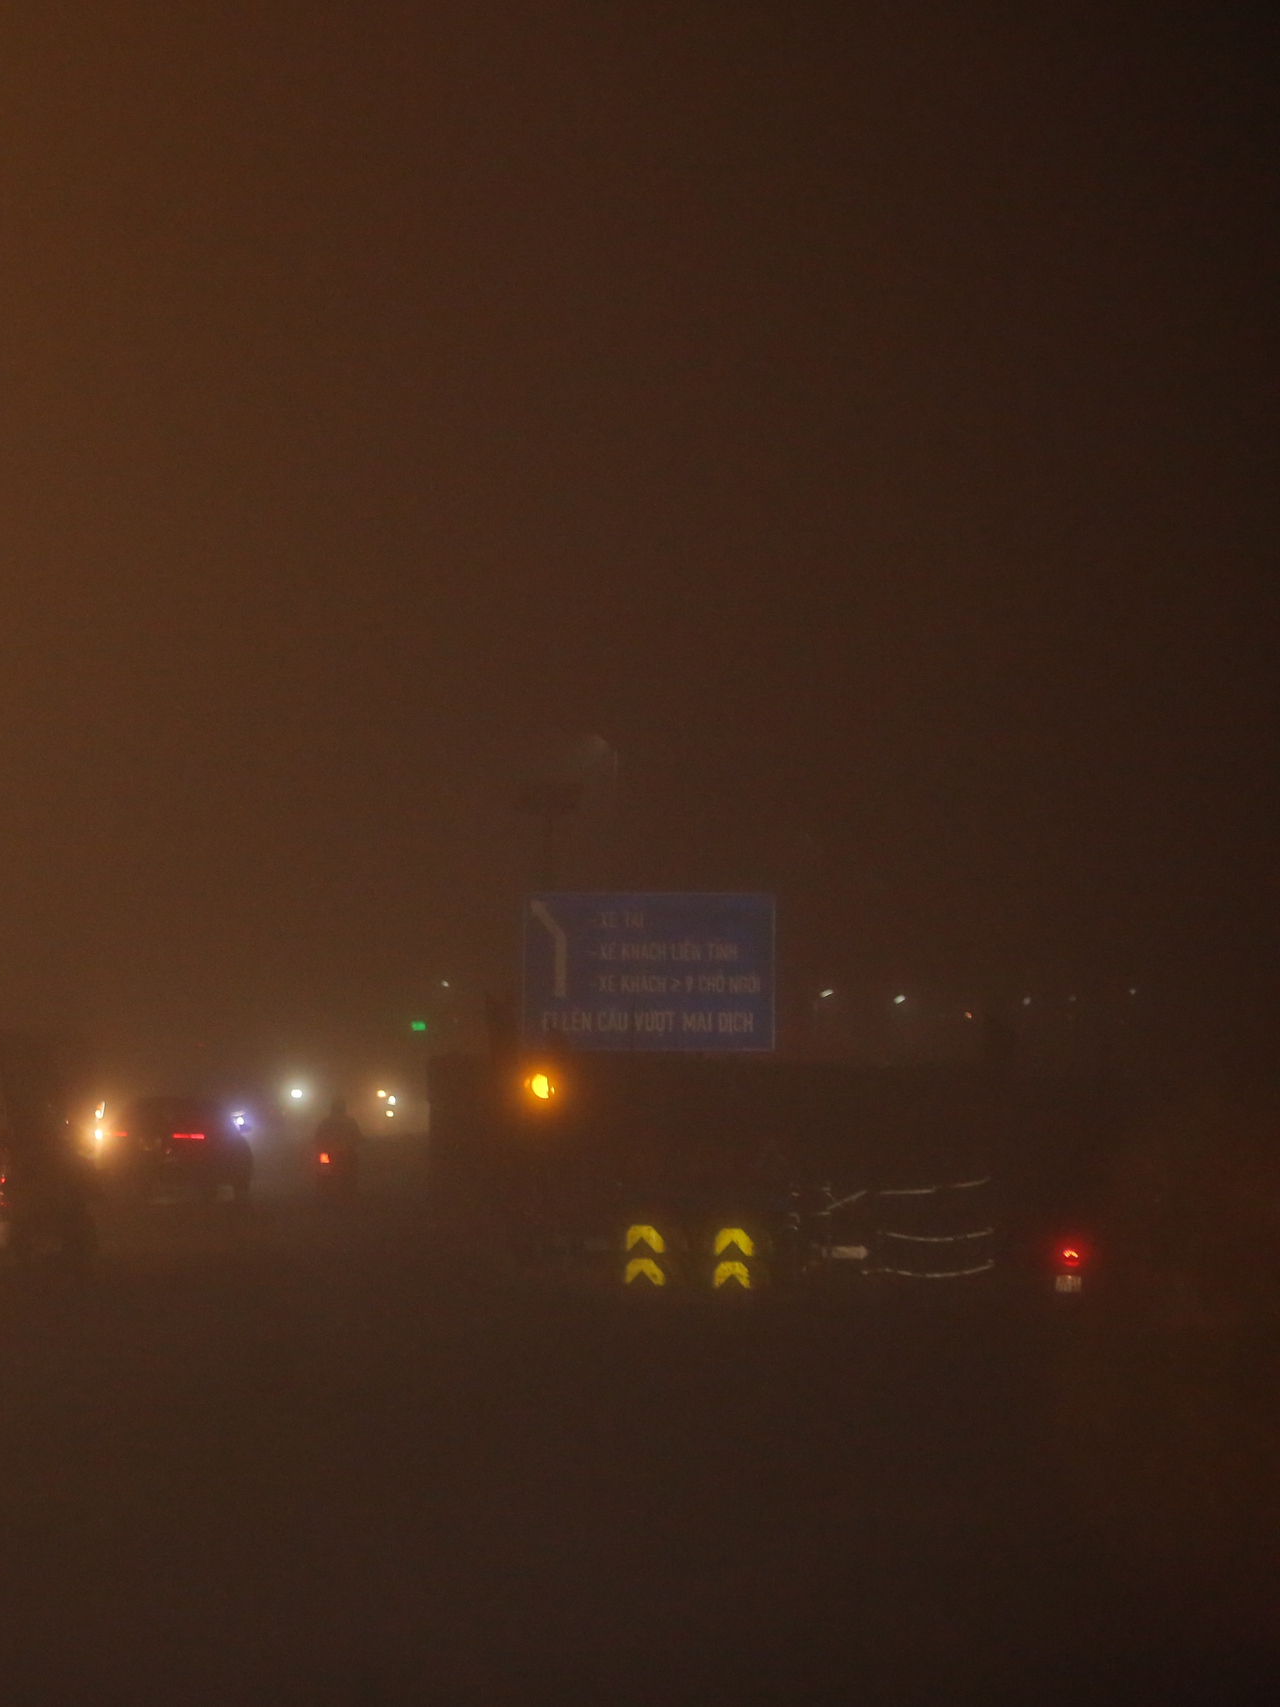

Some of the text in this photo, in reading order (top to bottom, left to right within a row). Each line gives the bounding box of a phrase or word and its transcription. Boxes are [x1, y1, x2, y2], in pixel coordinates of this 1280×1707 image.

[671, 938, 701, 961] LIÊN
[562, 1004, 592, 1032] LÊN
[682, 1011, 713, 1033] MAI
